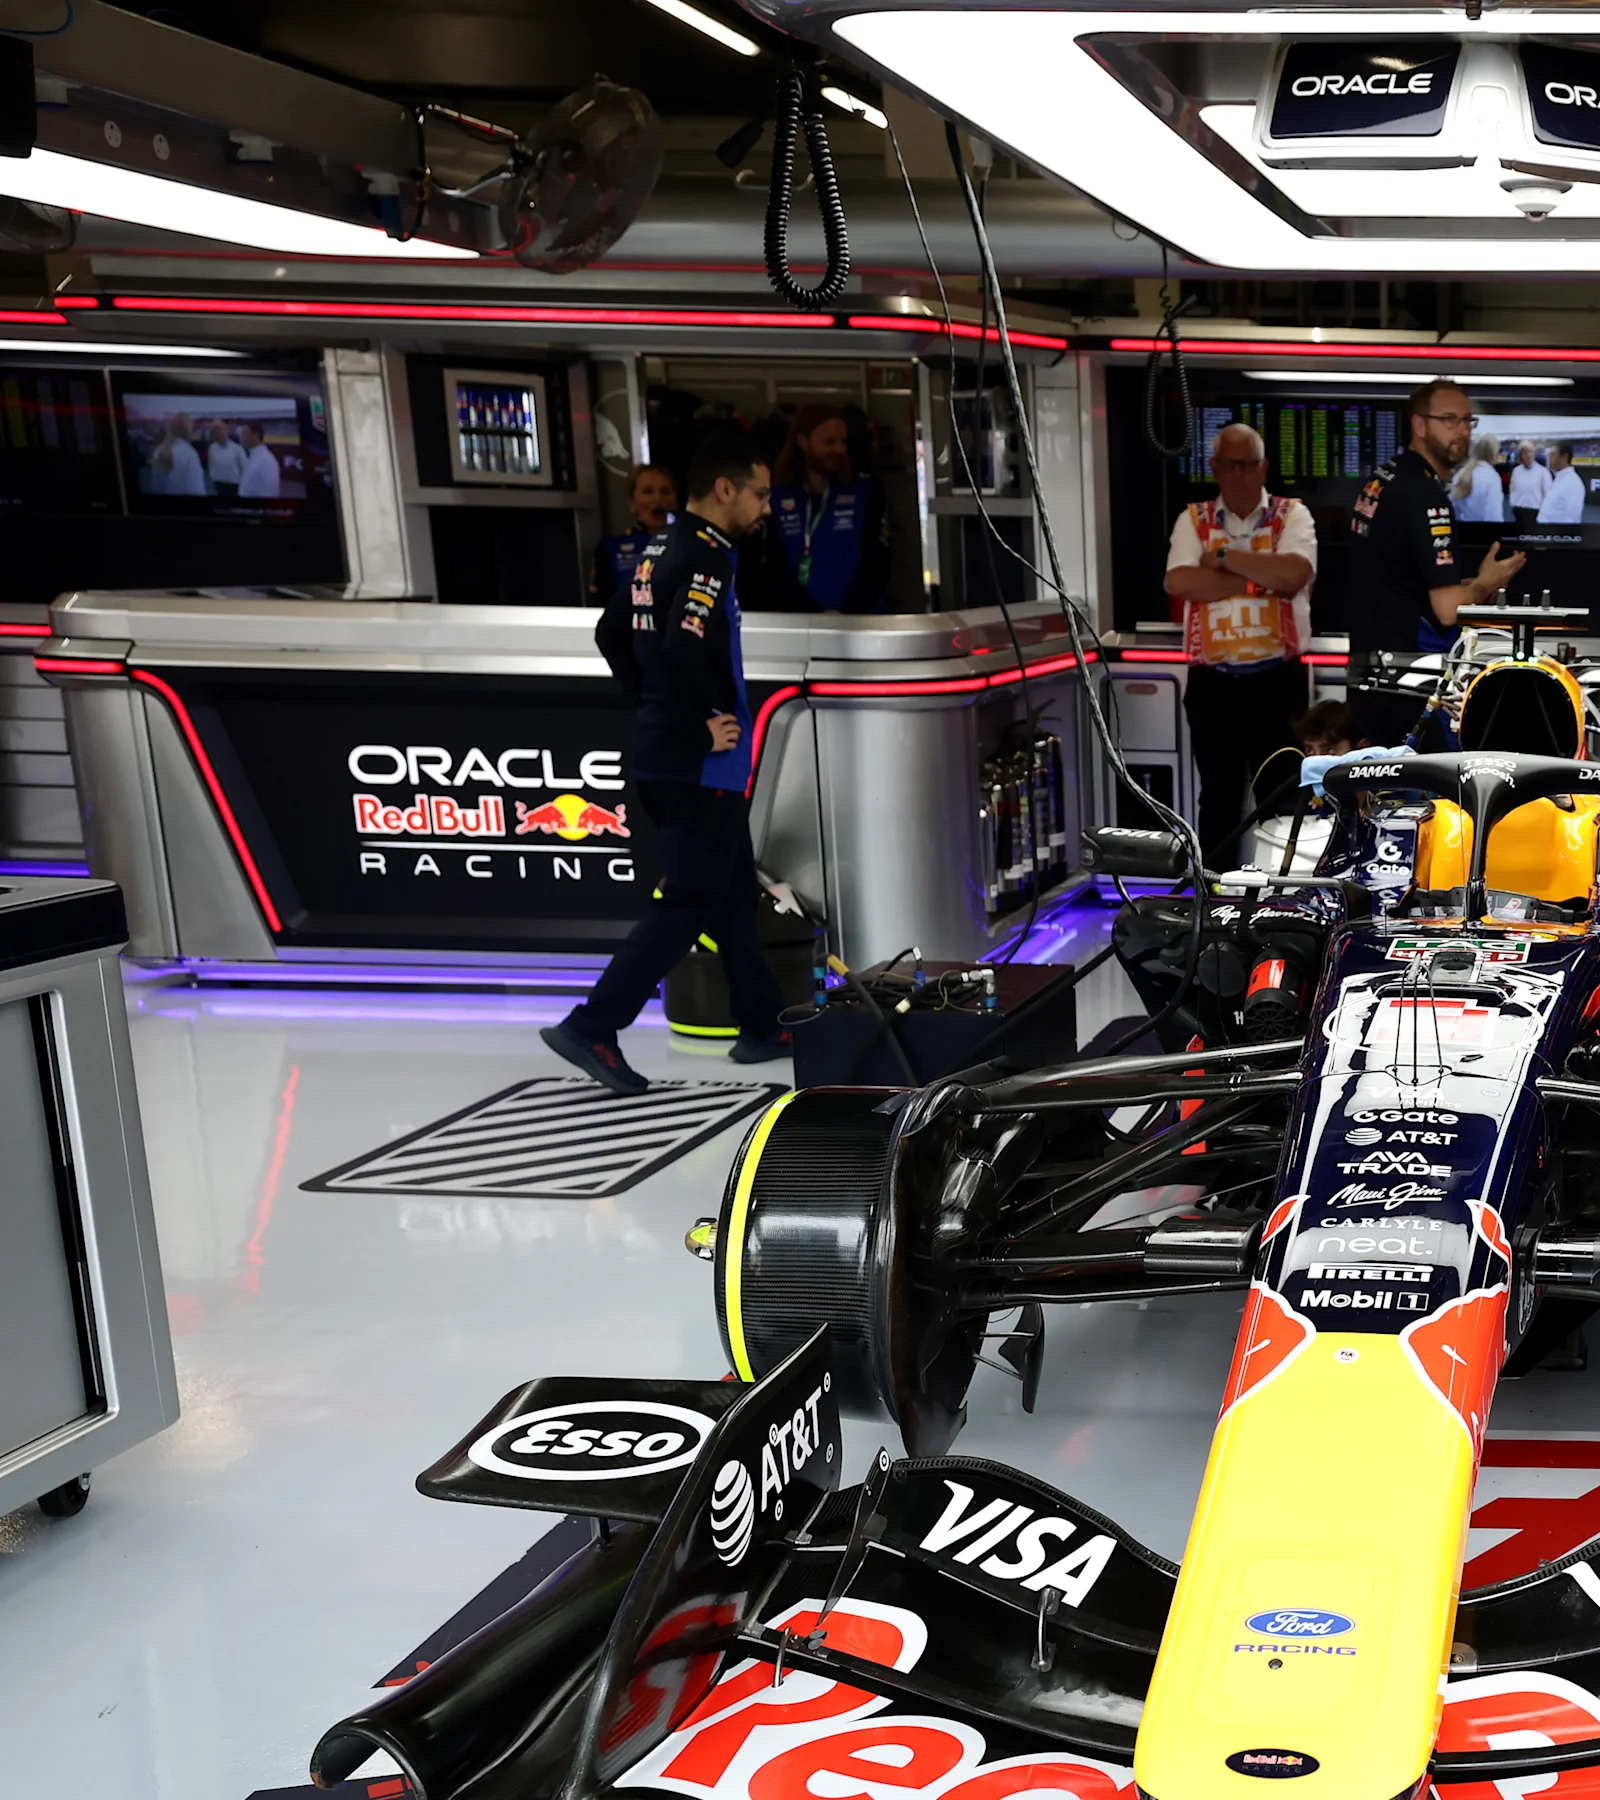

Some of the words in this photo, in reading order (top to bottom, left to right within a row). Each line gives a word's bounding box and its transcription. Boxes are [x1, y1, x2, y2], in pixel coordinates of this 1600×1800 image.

[1290, 72, 1434, 97] ORACLE
[347, 744, 626, 791] ORACLE
[1349, 763, 1404, 779] DAMAC
[1464, 757, 1517, 772] TESCO
[359, 852, 636, 882] RACING
[1366, 863, 1411, 876] Gate
[1402, 939, 1520, 950] TAG
[1380, 1110, 1459, 1125] Gate
[1386, 1130, 1459, 1146] AT&T
[1362, 1151, 1428, 1164] AVA
[1336, 1162, 1453, 1178] TRADE
[1327, 1183, 1387, 1205] Maui
[1384, 1182, 1448, 1211] Jim
[1320, 1217, 1443, 1232] CARLYLE
[1317, 1236, 1434, 1256] neat.
[1306, 1262, 1434, 1283] PIRELLI
[1299, 1289, 1394, 1310] Mobil
[511, 1423, 688, 1460] Esso
[761, 1385, 823, 1513] AT&T
[919, 1479, 1119, 1608] VISA
[1266, 1611, 1335, 1635] Ford
[1233, 1643, 1358, 1656] RACING
